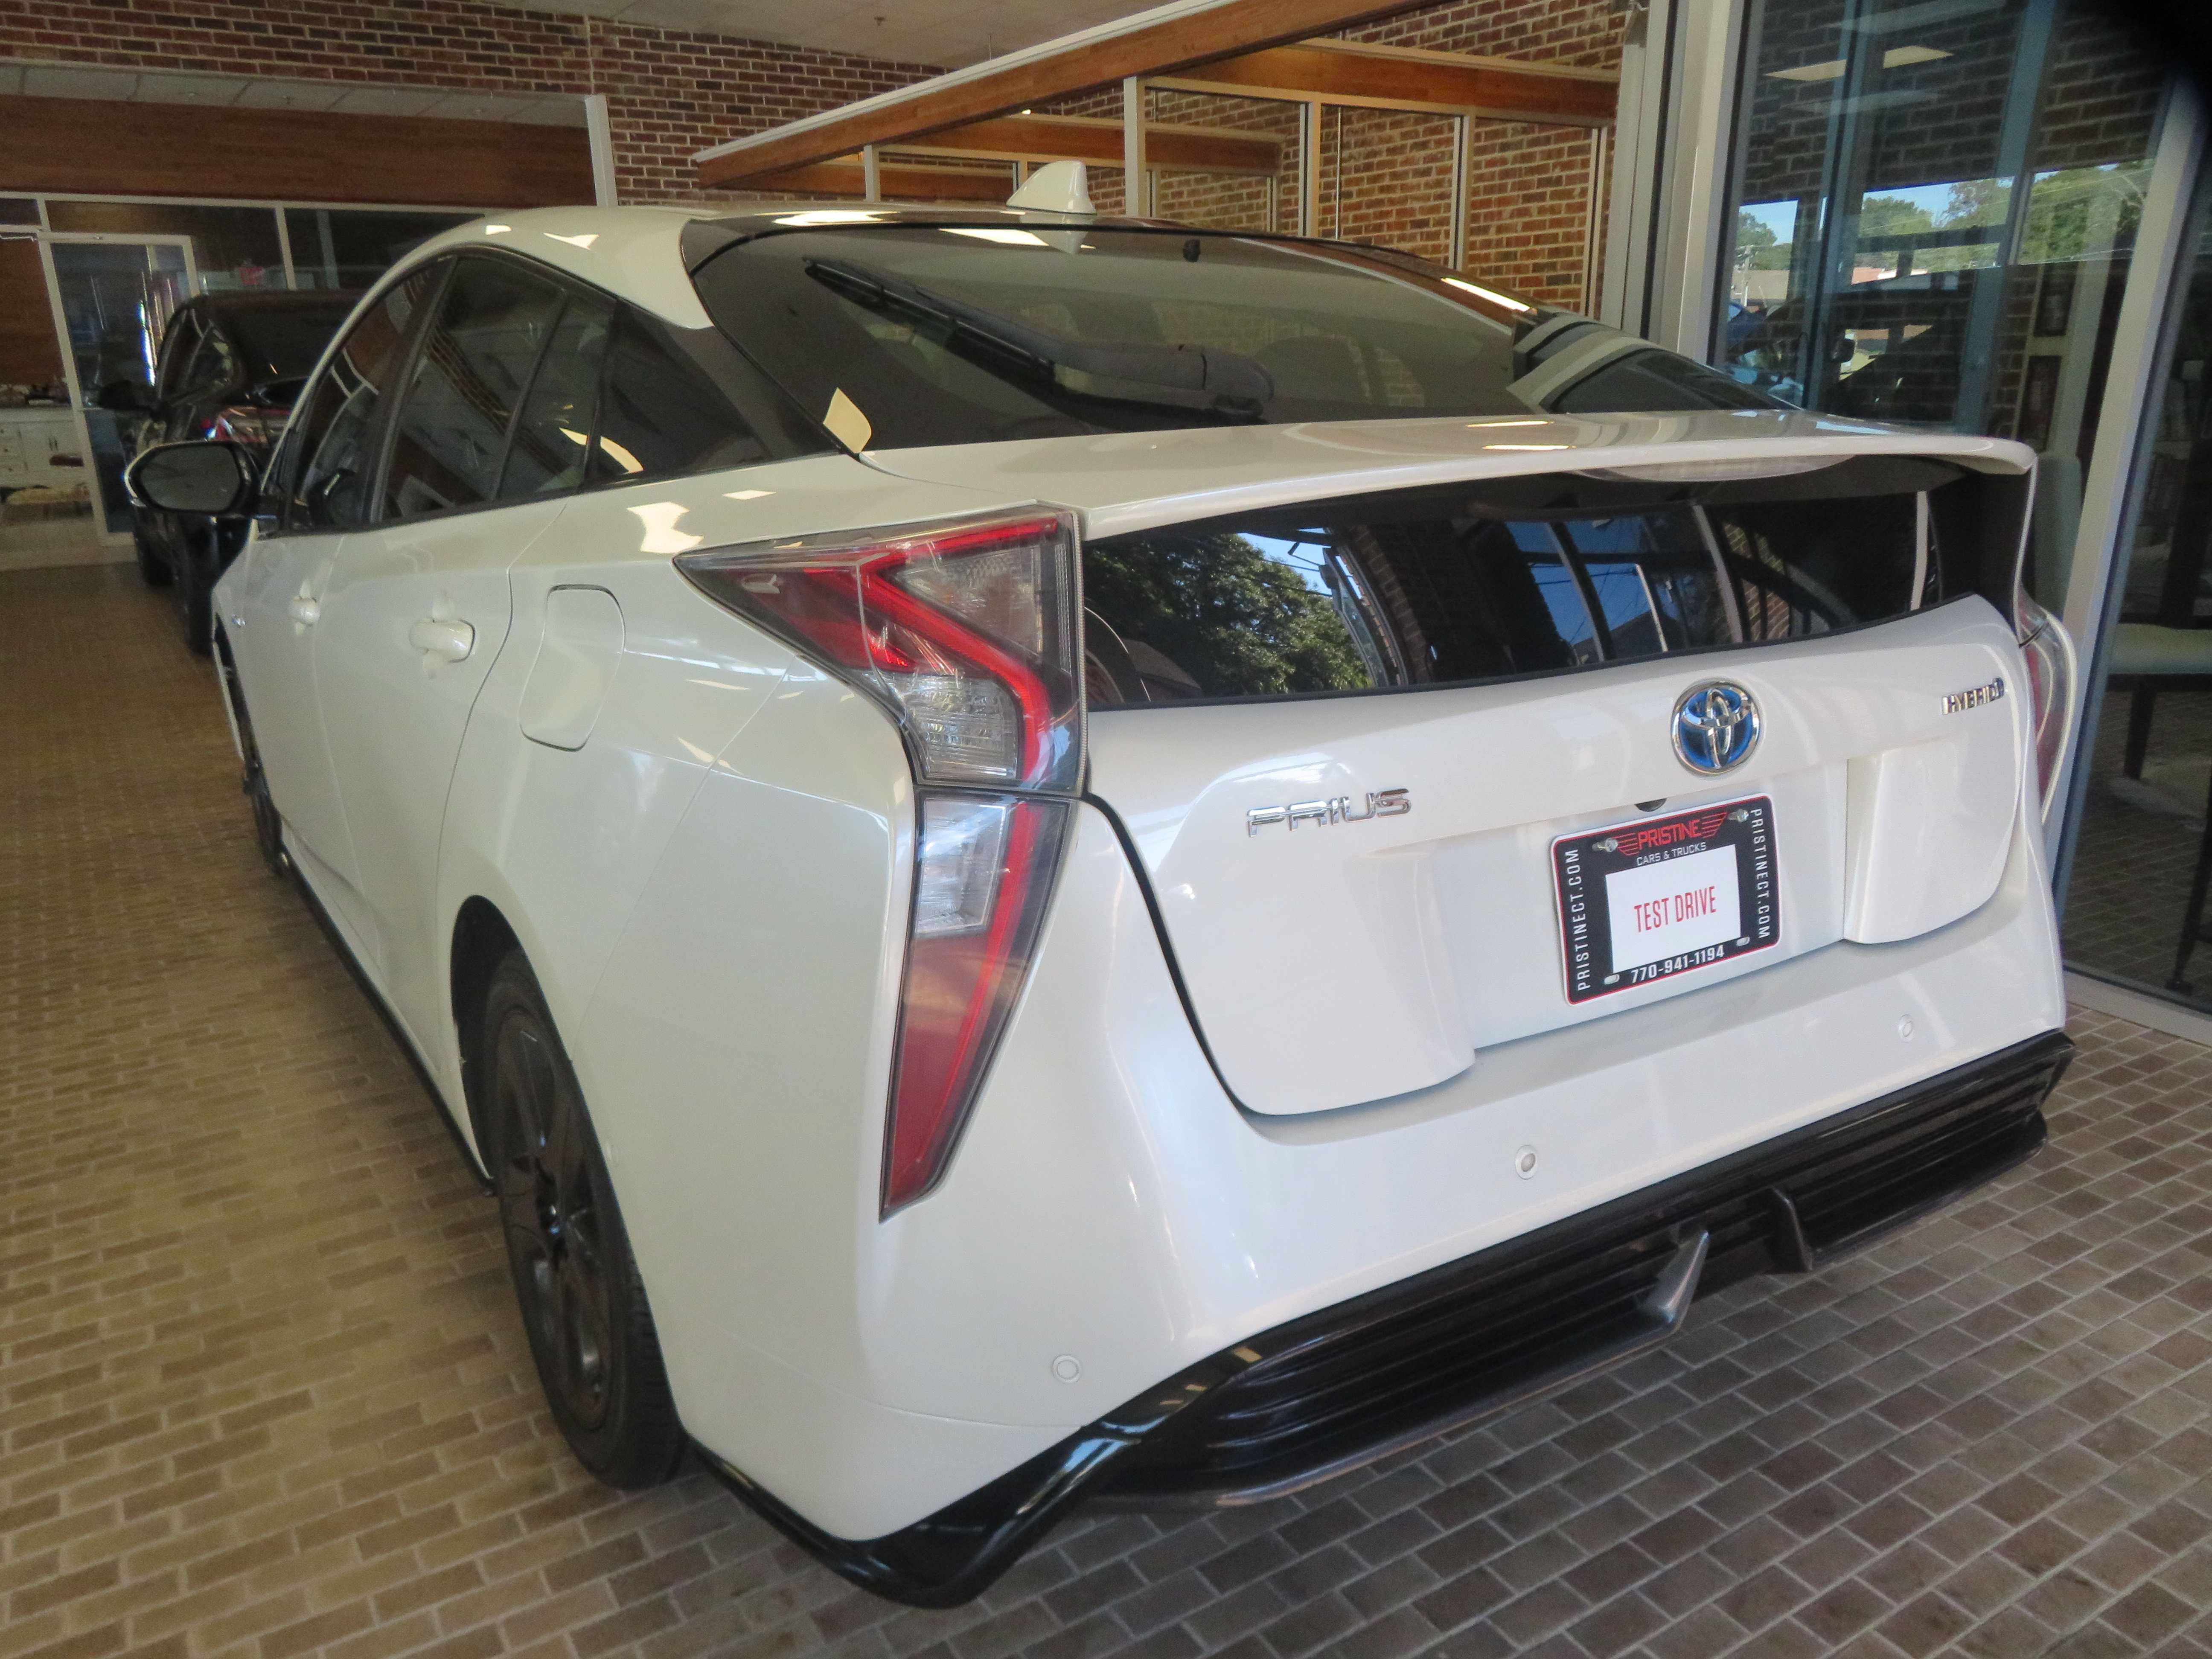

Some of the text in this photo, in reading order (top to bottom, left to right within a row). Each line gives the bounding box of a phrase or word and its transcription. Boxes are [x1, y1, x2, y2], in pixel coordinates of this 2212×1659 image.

[1246, 788, 1412, 838] PRIUS
[1637, 819, 1702, 850] PRISTINE
[1636, 841, 1707, 866] CARS & TRUCKS
[1749, 808, 1771, 939] PRISTINECT.COM
[1564, 849, 1591, 991] PRISTINECT.COM
[1634, 885, 1717, 933] TEST DRIVE
[1630, 945, 1725, 984] 770-941-1194
